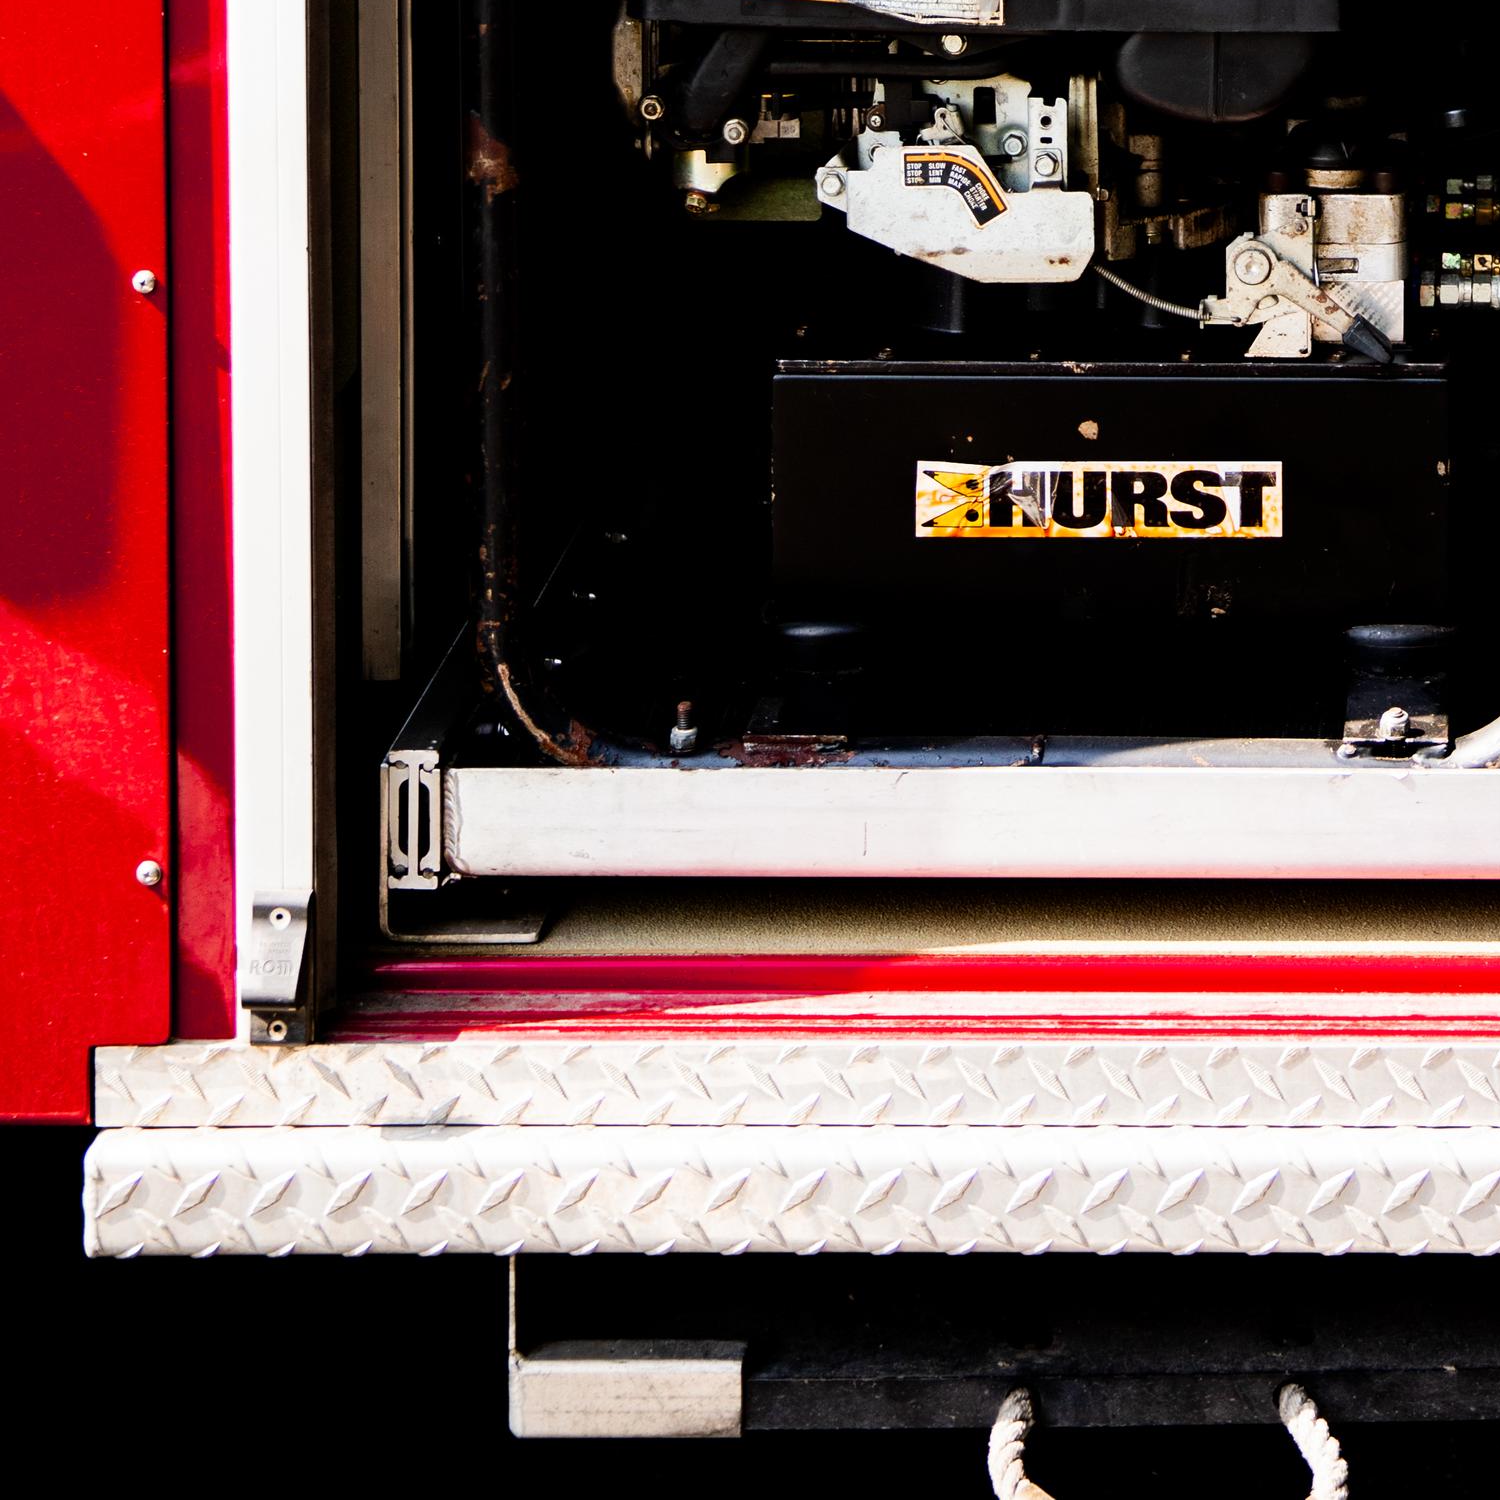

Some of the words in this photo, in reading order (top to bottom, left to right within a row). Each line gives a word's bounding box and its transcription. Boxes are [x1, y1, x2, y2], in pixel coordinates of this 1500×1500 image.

[906, 162, 922, 170] STOP
[928, 162, 946, 170] SLOW
[951, 164, 966, 175] FAST
[947, 177, 962, 189] MAX
[989, 470, 1277, 529] HURST
